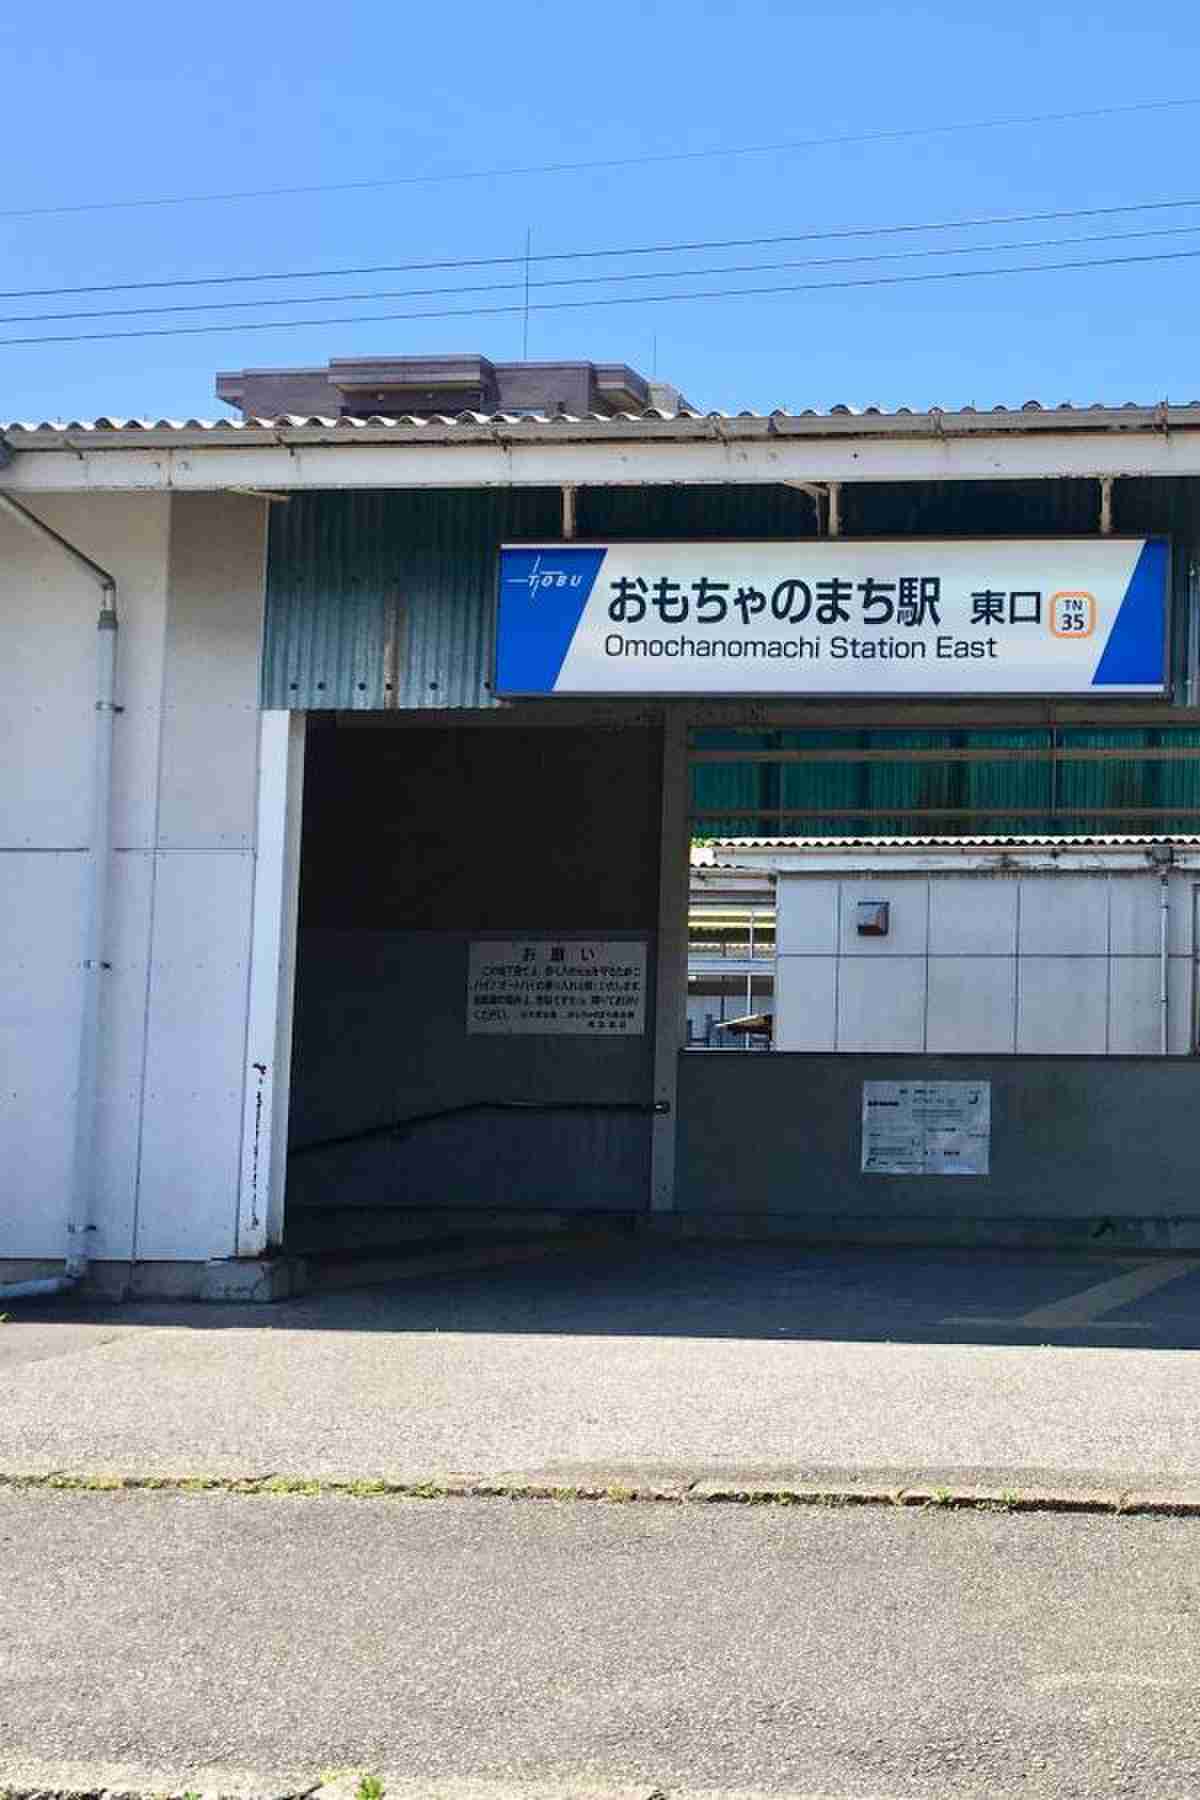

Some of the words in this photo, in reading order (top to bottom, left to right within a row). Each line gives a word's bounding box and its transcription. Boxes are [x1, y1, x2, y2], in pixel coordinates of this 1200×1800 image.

[608, 577, 941, 627] おもちゃのまち駅
[970, 590, 1042, 625] 東口
[1064, 599, 1083, 611] TN
[1061, 614, 1085, 631] 35
[605, 634, 820, 659] Omochanomachi
[829, 636, 926, 659] Station
[936, 636, 999, 659] East
